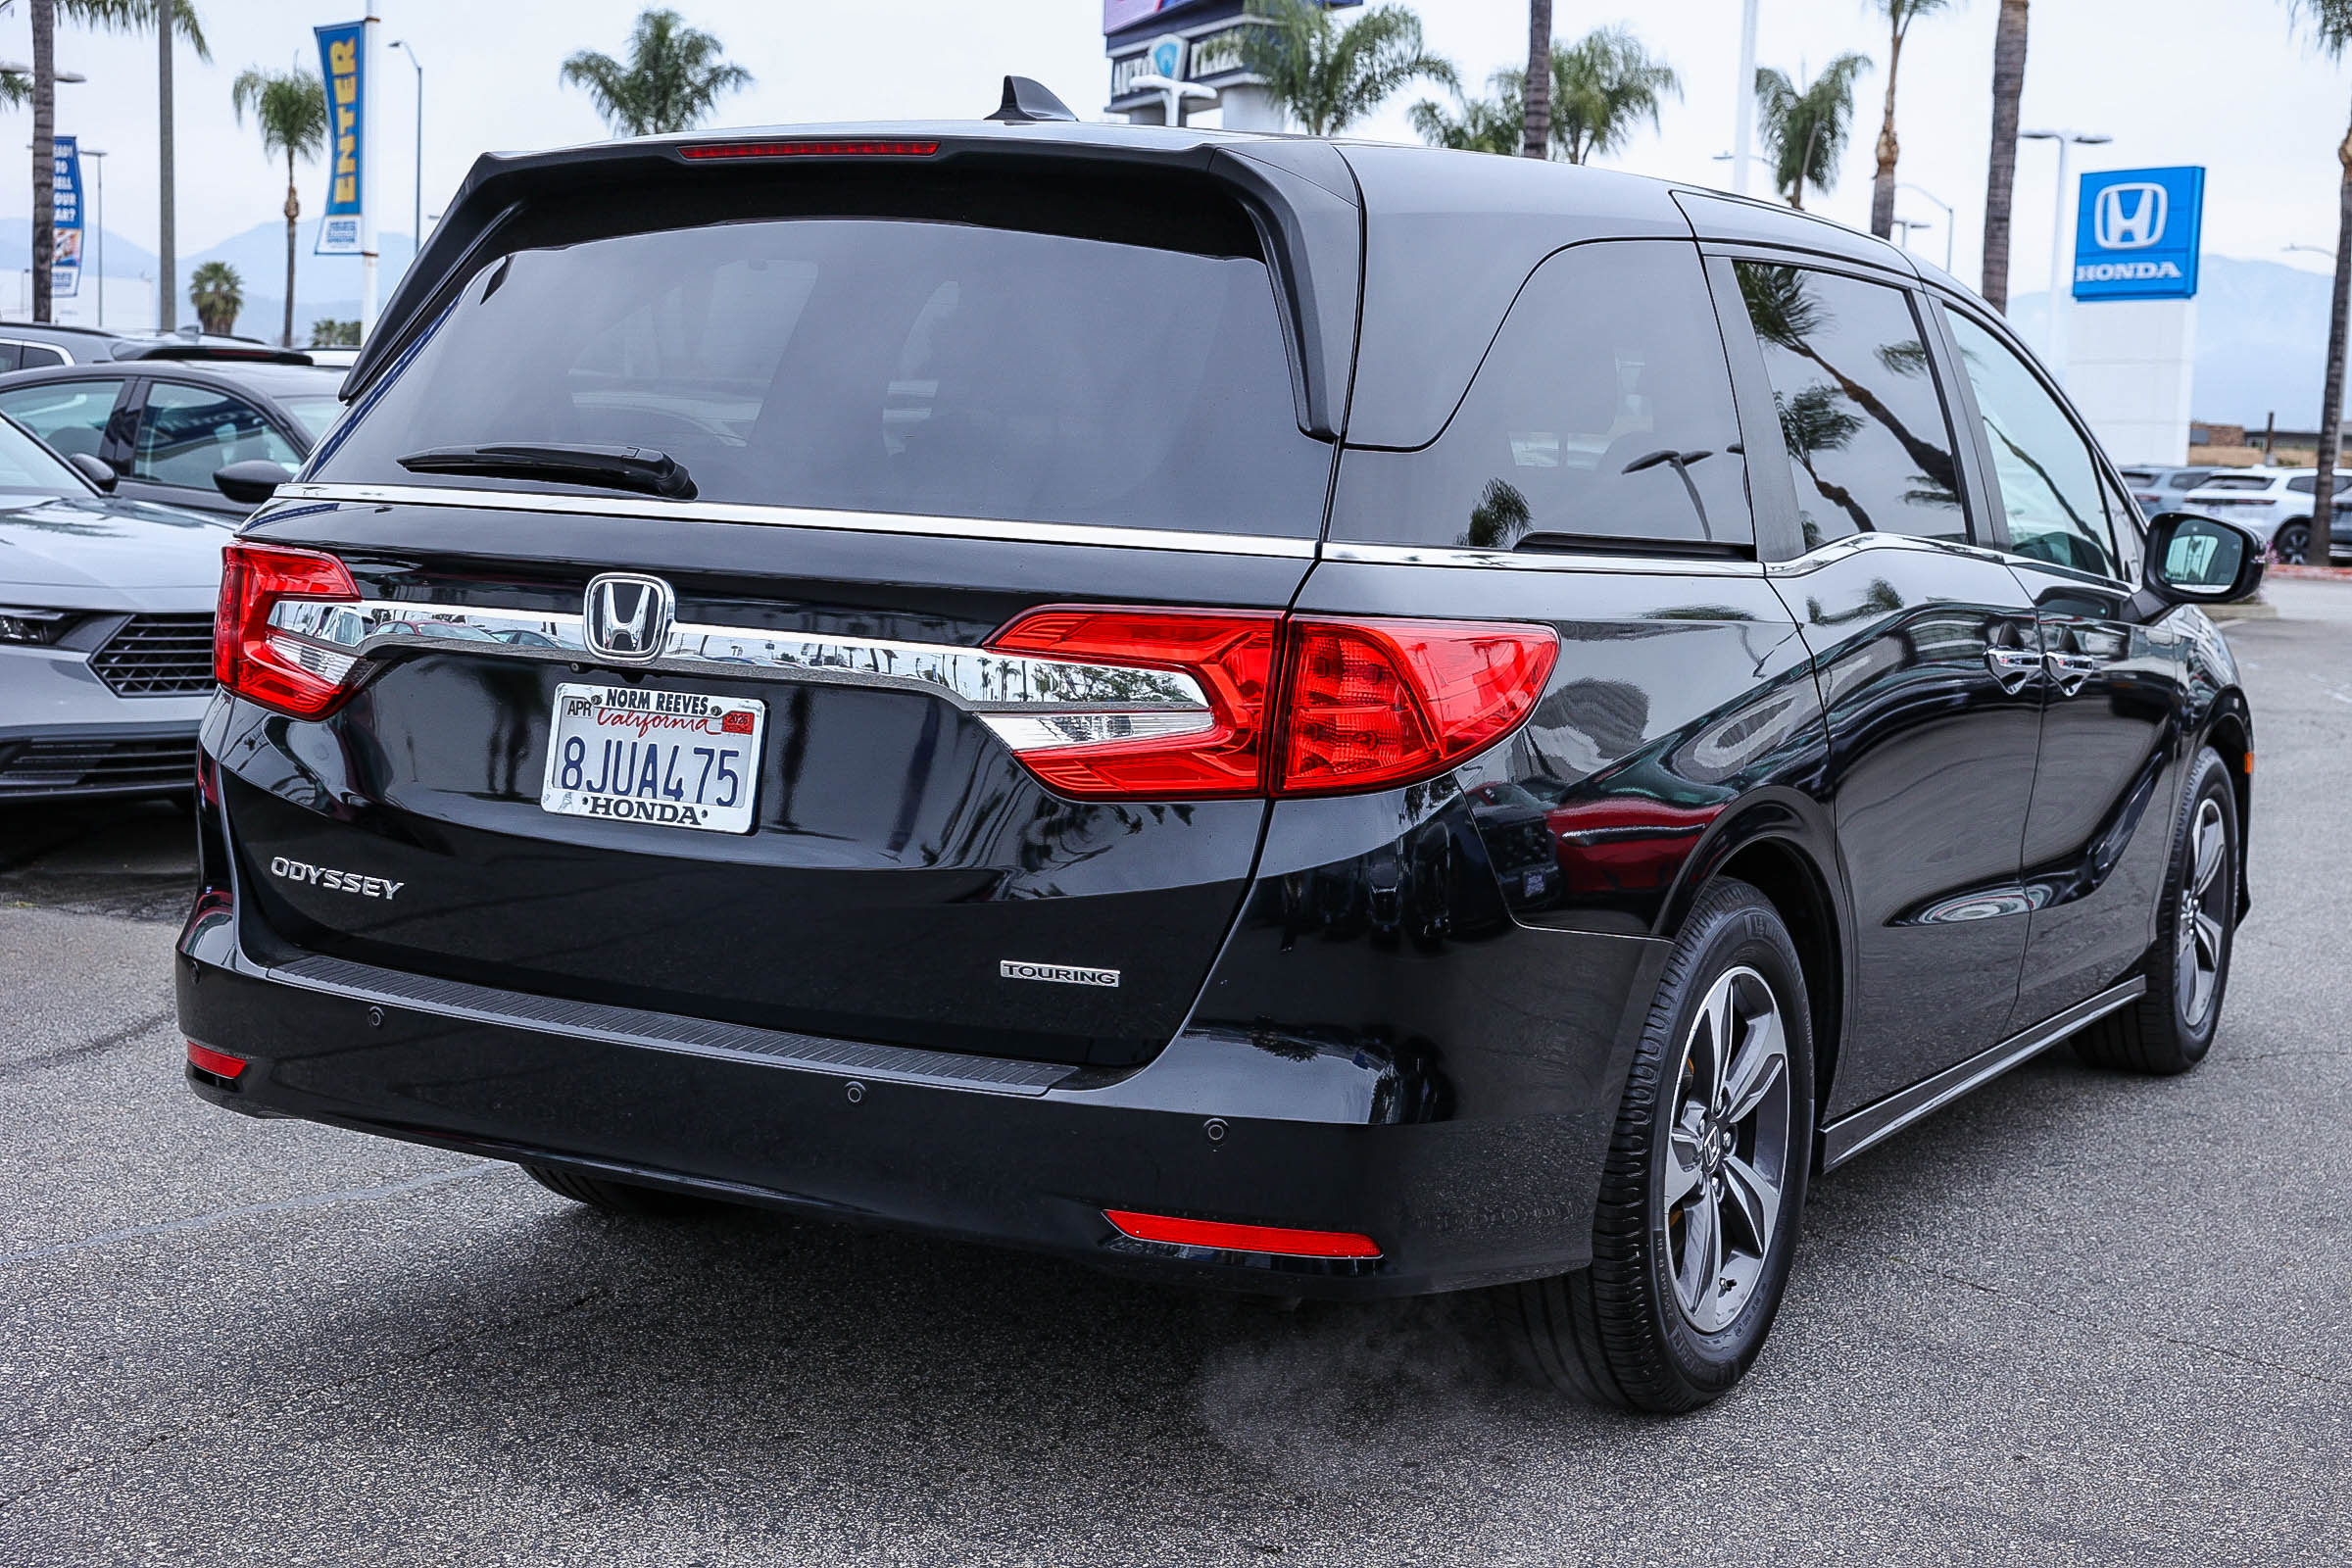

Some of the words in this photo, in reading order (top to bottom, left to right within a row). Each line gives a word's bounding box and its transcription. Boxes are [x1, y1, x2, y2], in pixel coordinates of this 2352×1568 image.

[329, 36, 357, 204] ENTER
[2076, 261, 2181, 282] HONDA
[566, 700, 592, 717] APR
[606, 688, 651, 710] NORM
[656, 692, 709, 715] REEVES
[597, 707, 722, 739] California
[561, 736, 740, 807] 8JUA475
[589, 796, 702, 826] HONDA
[270, 856, 406, 901] ODYSSEY
[1003, 964, 1116, 985] TOURING
